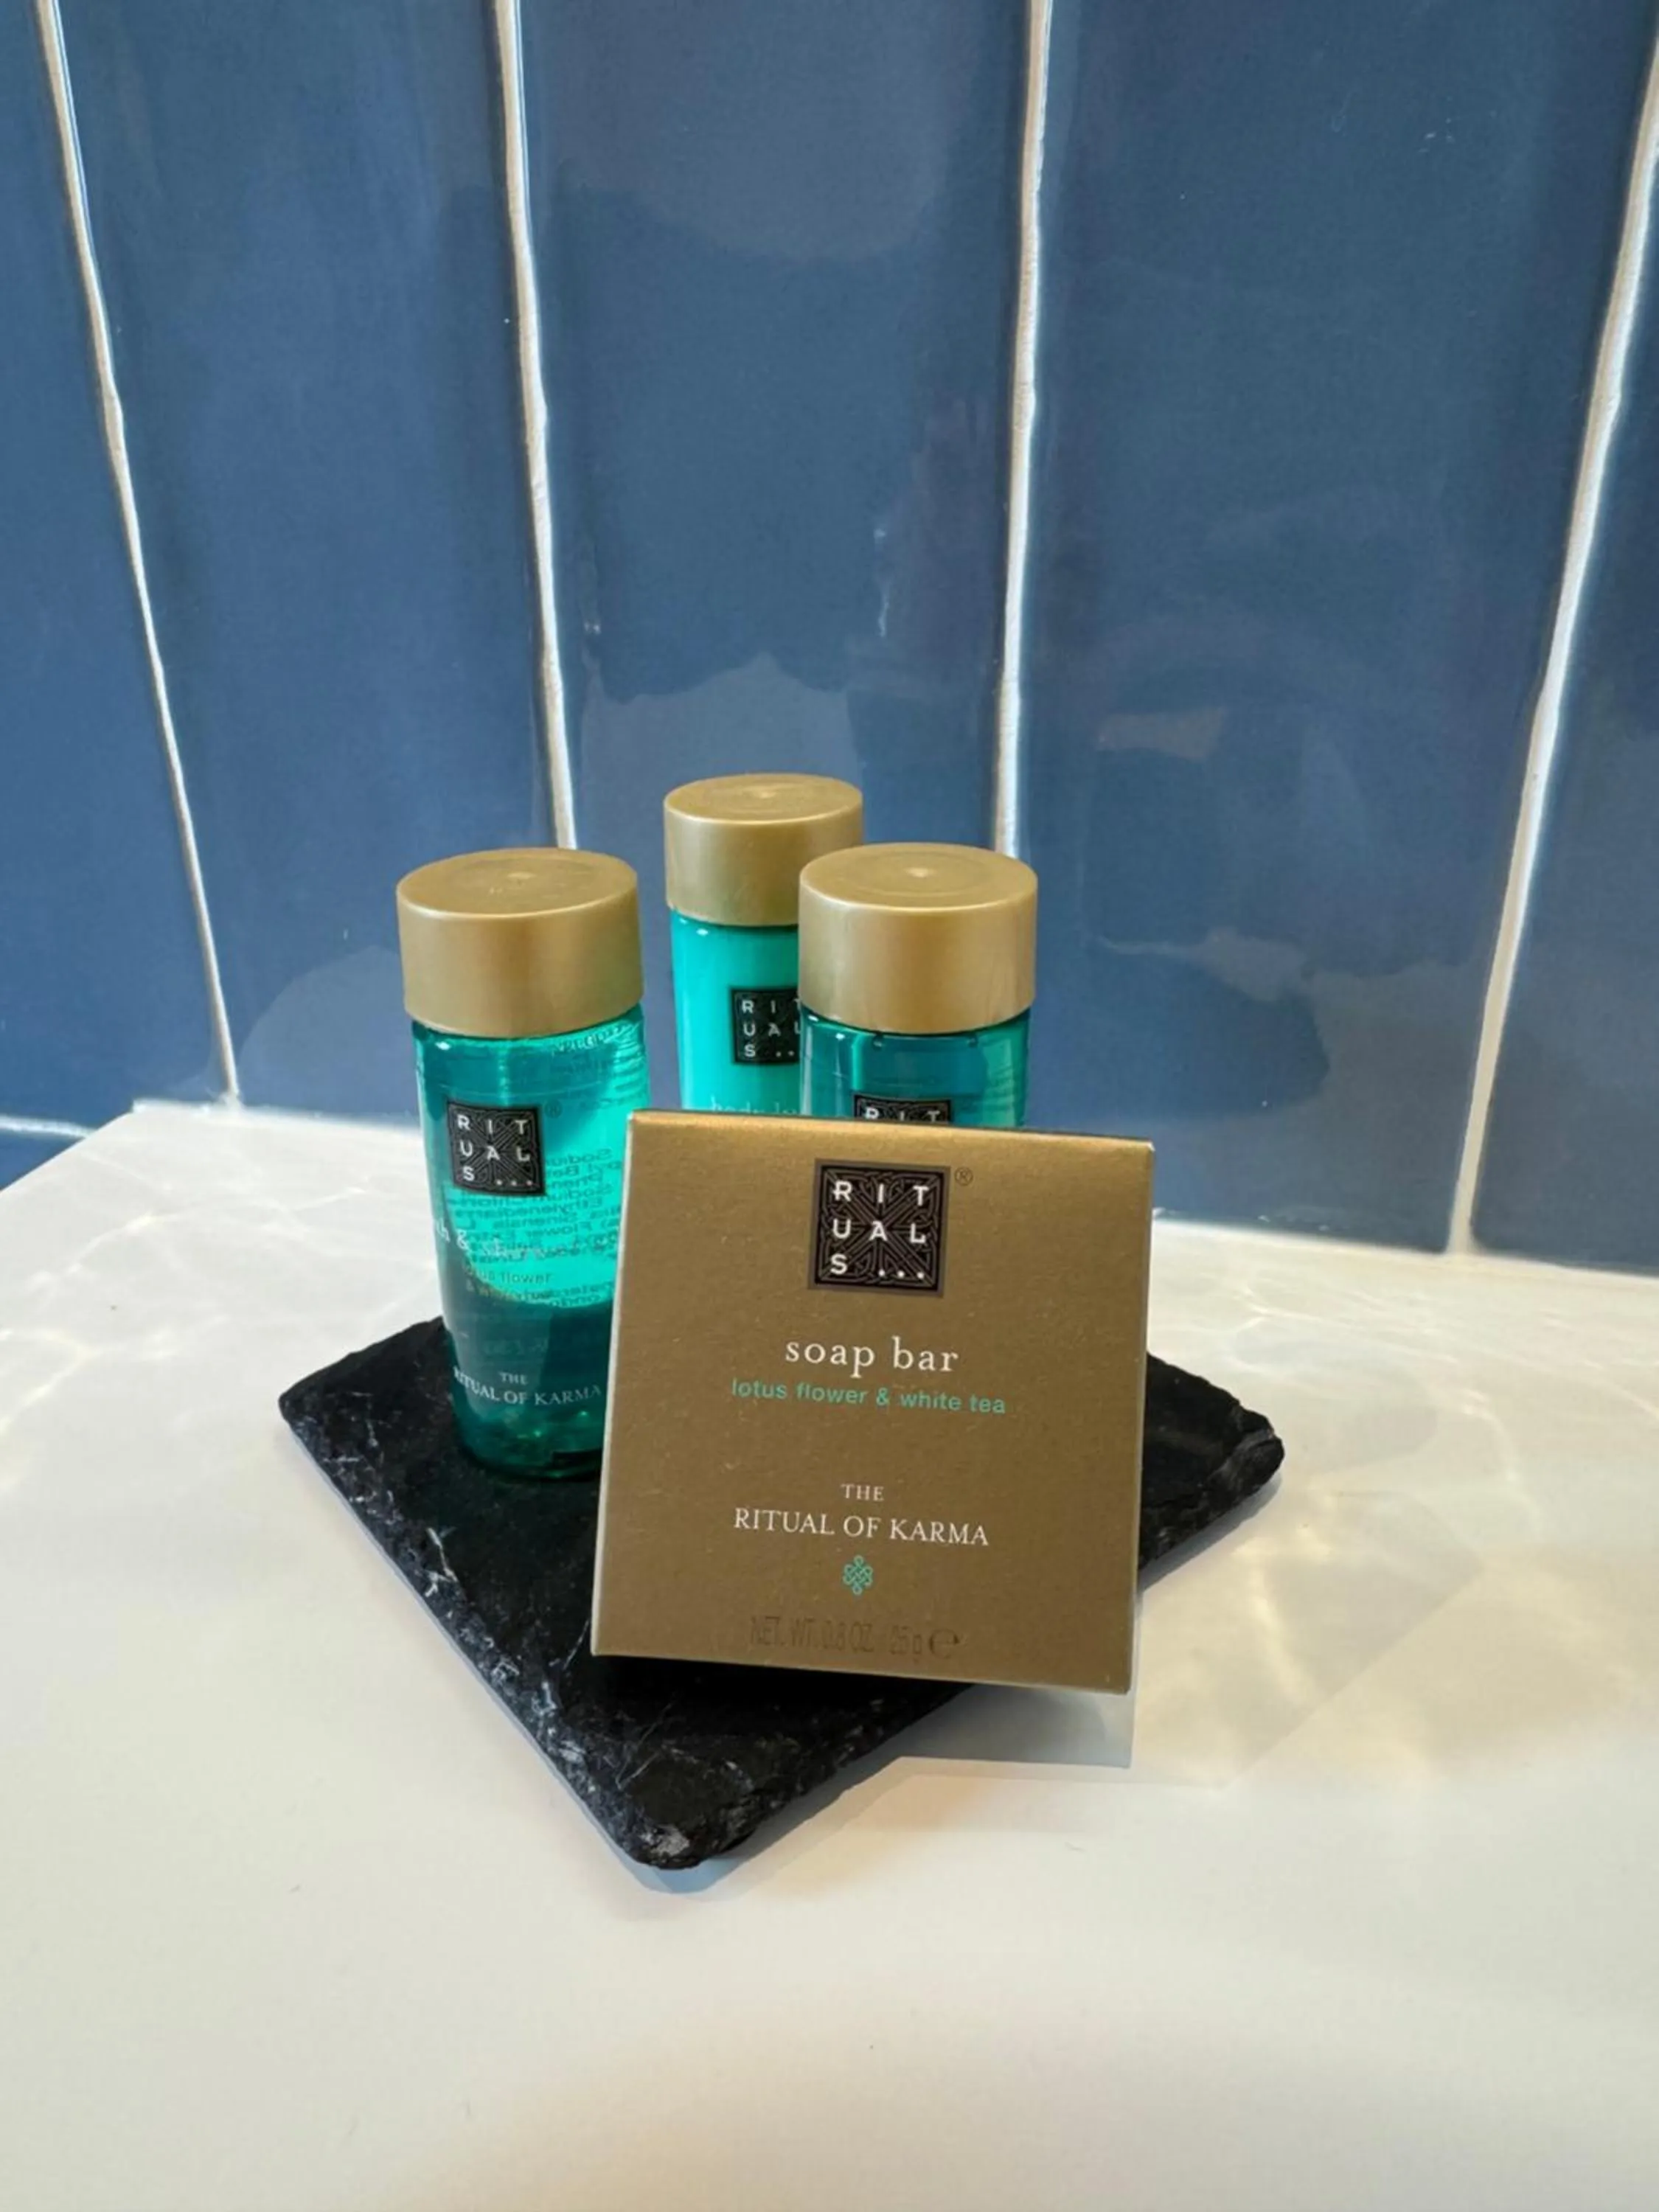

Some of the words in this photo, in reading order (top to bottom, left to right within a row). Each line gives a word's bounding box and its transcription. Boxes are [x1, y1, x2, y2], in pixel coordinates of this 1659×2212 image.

[785, 1340, 876, 1379] soap
[891, 1335, 959, 1372] bar
[498, 1371, 529, 1385] THE
[503, 1390, 528, 1405] OF
[534, 1384, 602, 1405] KARMA
[731, 1378, 787, 1399] lotus
[796, 1381, 869, 1405] flower
[875, 1387, 890, 1407] &
[900, 1389, 962, 1411] white
[969, 1393, 1006, 1414] tea
[841, 1483, 885, 1503] THE
[733, 1506, 836, 1537] RITUAL
[843, 1514, 882, 1539] OF
[889, 1517, 990, 1547] KARMA
